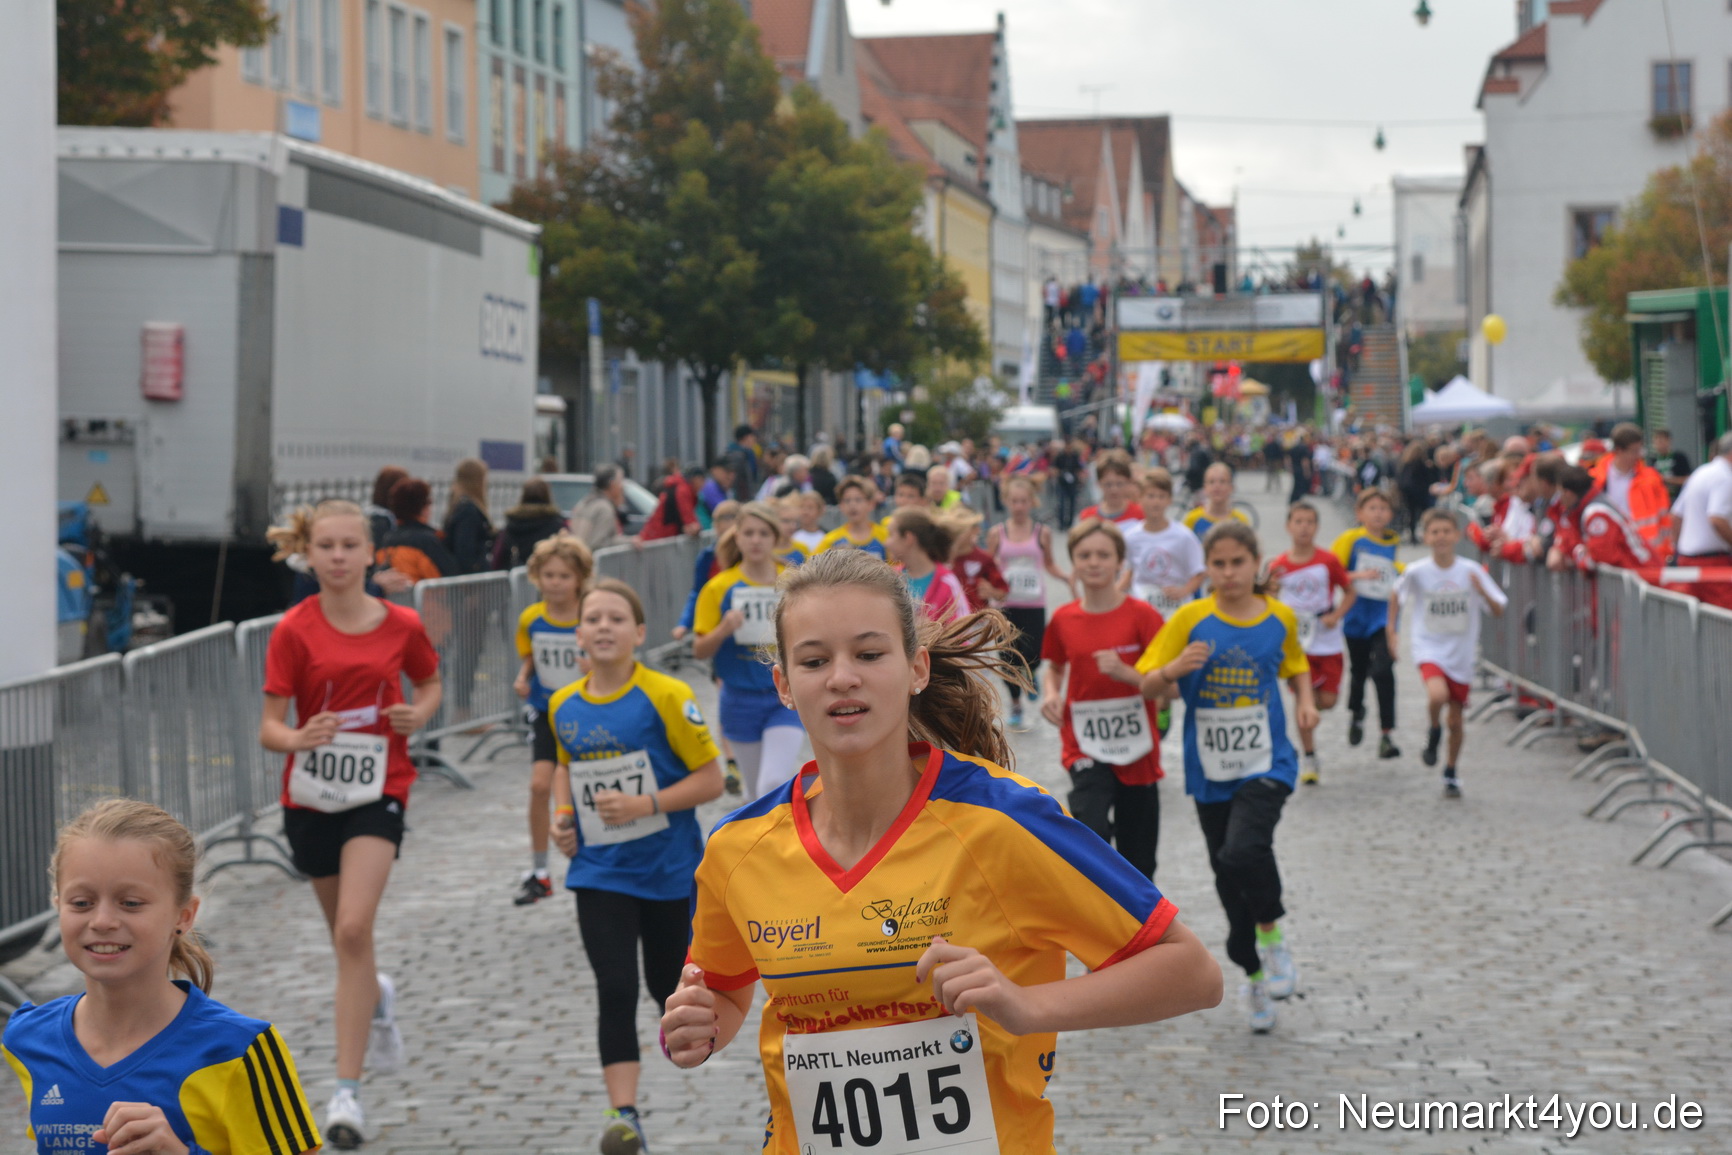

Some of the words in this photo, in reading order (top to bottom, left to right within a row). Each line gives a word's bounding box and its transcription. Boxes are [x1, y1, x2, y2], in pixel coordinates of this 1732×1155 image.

[1187, 335, 1256, 354] START
[740, 600, 779, 622] 410
[1083, 713, 1142, 741] 4025
[1204, 723, 1262, 752] 4022
[304, 749, 375, 785] 4008
[861, 896, 951, 921] Balance
[917, 912, 949, 927] Dich
[747, 915, 821, 950] Deyerl
[828, 987, 849, 1002] für
[787, 1051, 843, 1071] PARTL
[846, 1040, 943, 1067] Neumarkt
[811, 1063, 971, 1148] 4015
[45, 1136, 96, 1148] LANGE
